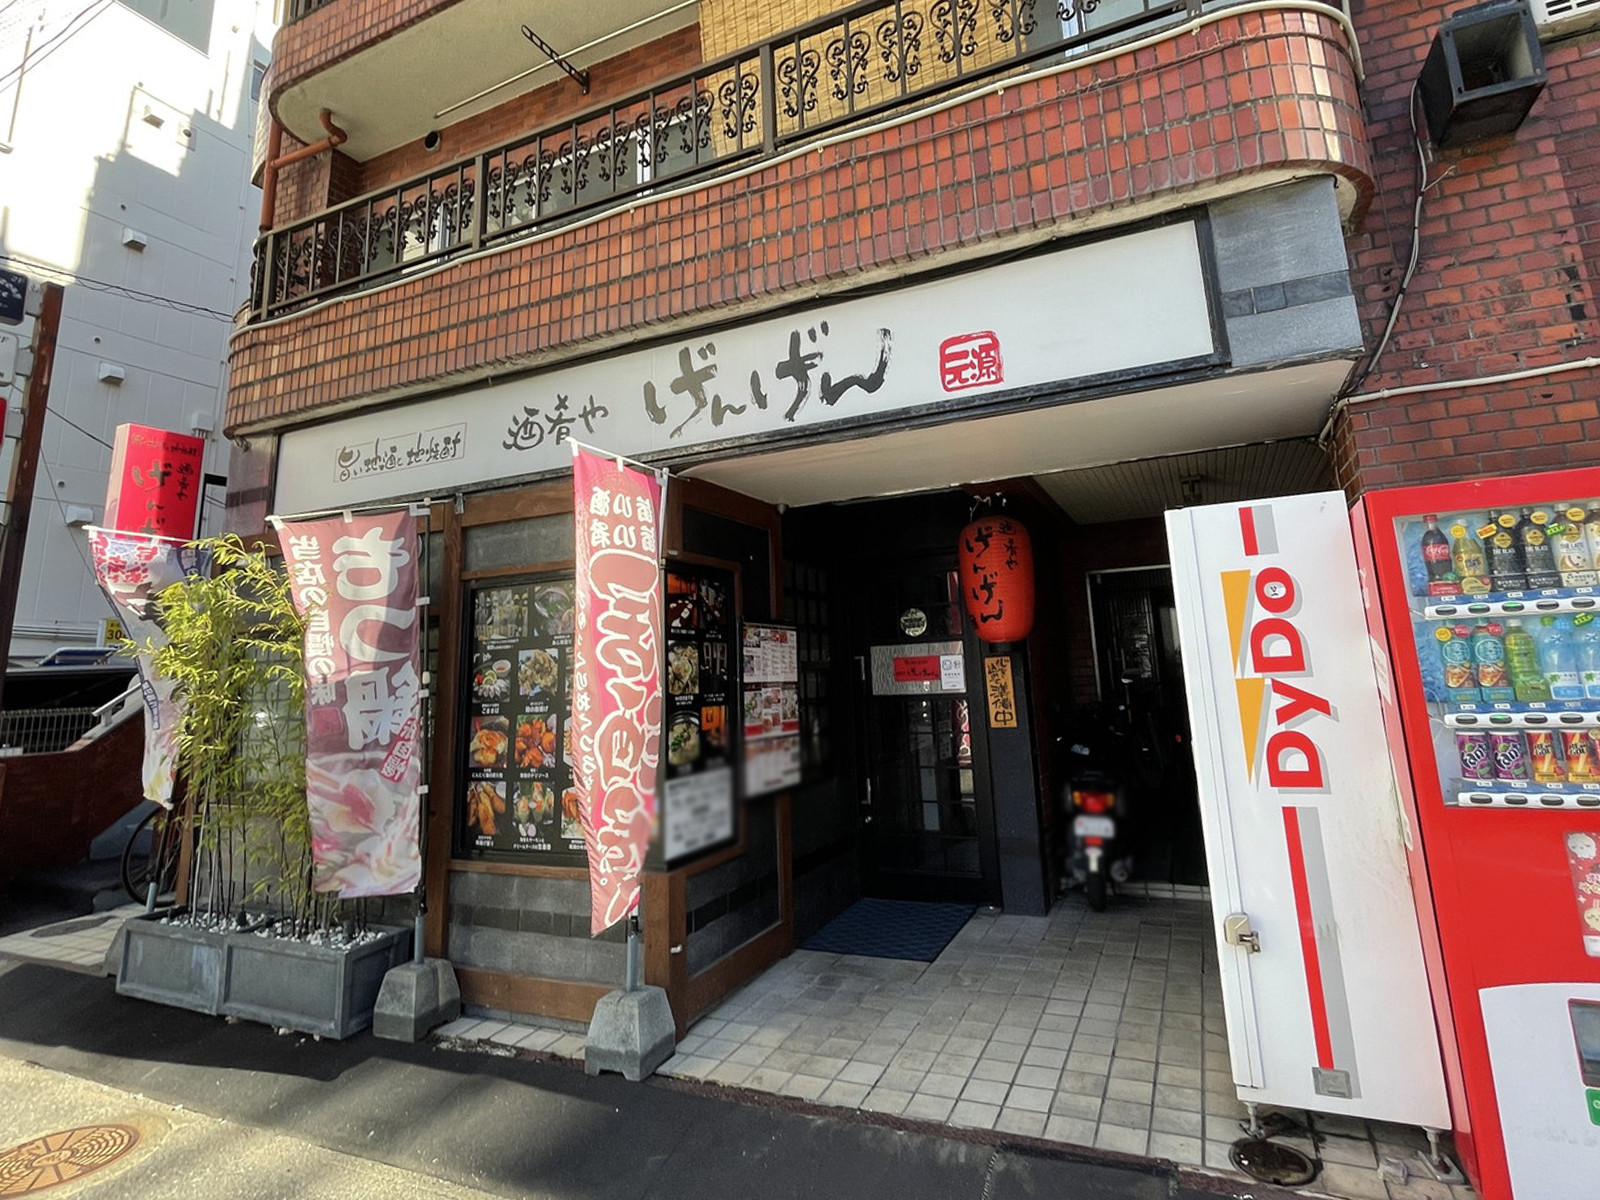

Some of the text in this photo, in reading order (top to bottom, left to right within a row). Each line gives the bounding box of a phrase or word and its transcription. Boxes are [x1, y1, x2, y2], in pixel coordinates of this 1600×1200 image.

[643, 320, 892, 439] げんげん
[965, 527, 1004, 624] げんげん
